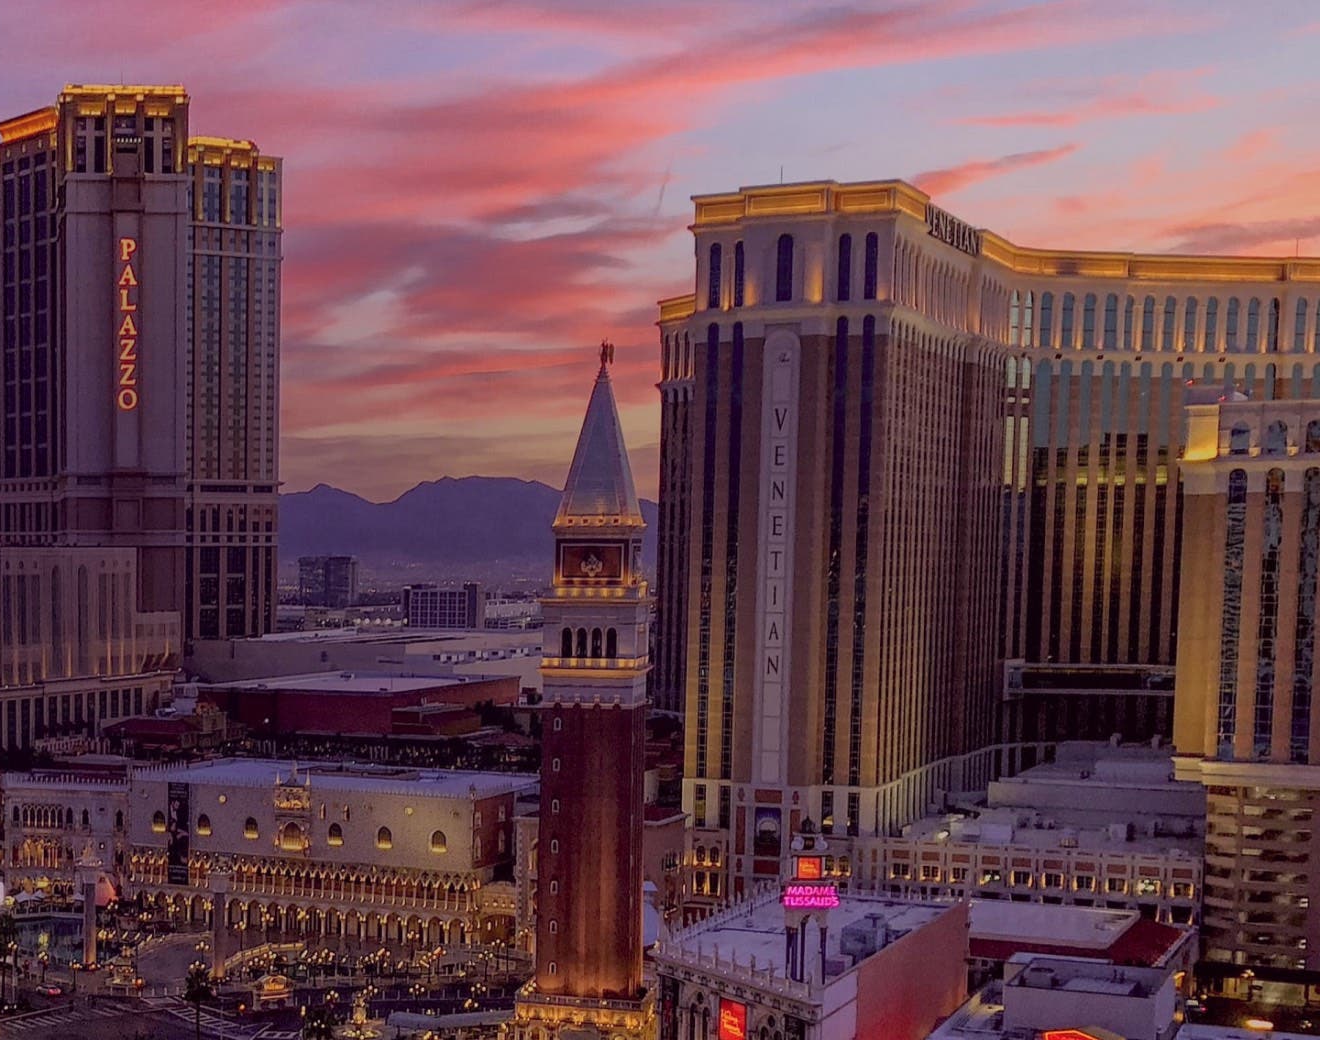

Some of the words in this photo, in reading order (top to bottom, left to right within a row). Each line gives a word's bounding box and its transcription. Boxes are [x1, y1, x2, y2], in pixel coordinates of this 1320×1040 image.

[118, 238, 138, 410] PALAZZO
[766, 407, 787, 675] VENETIAN
[787, 886, 836, 896] MADAME
